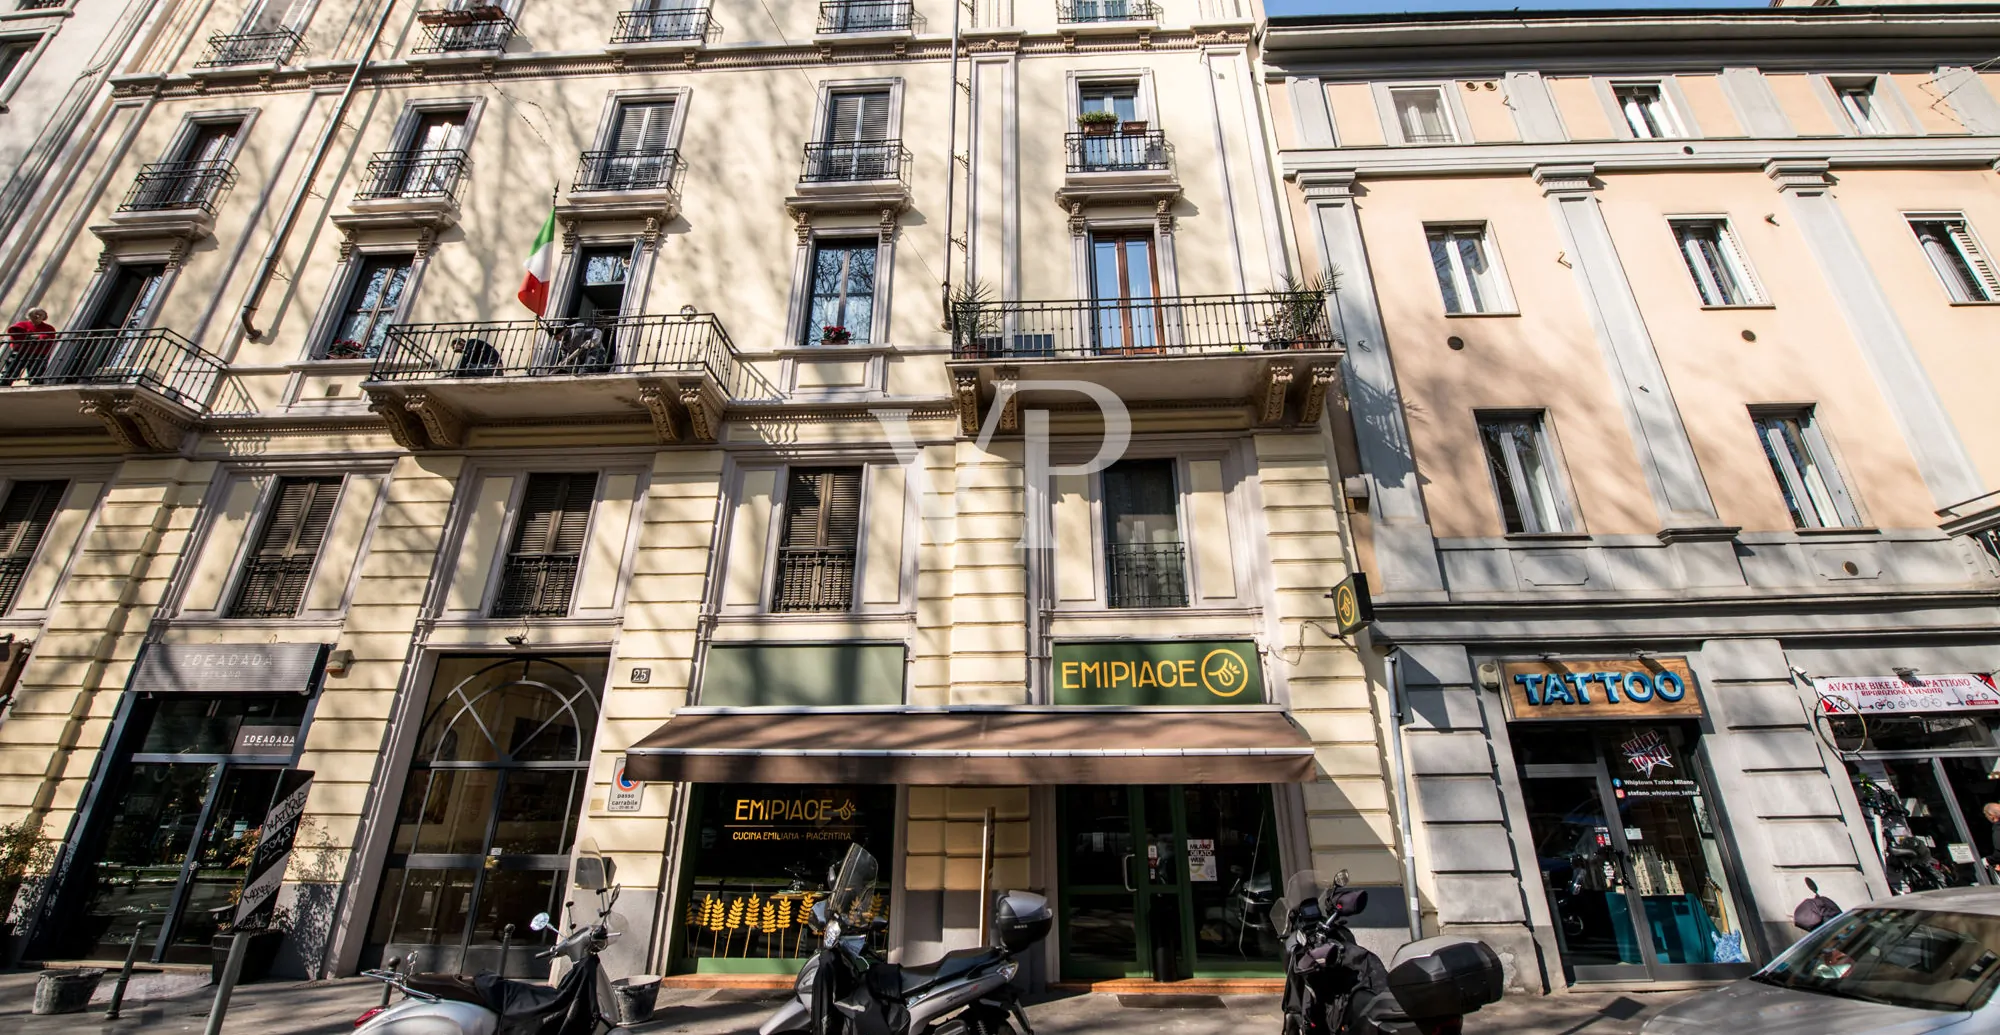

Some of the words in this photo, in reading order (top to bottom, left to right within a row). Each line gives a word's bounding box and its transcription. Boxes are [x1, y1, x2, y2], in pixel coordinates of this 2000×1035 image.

[181, 653, 273, 667] IDEADADA
[633, 669, 648, 682] 25
[1062, 660, 1198, 688] EMIPIACE
[1514, 671, 1685, 705] TATTOO
[1828, 682, 1866, 692] AVATAR
[1868, 681, 1892, 690] BIKE
[1892, 681, 1900, 689] E
[1860, 689, 1907, 697] RIPARAZIONE
[1914, 687, 1944, 695] VENDITA
[243, 734, 295, 744] IDEADADA
[735, 799, 833, 821] EMIPIACE
[732, 831, 762, 840] CUCINA
[762, 831, 800, 840] EMILIANA
[805, 831, 851, 840] PIACENTINA
